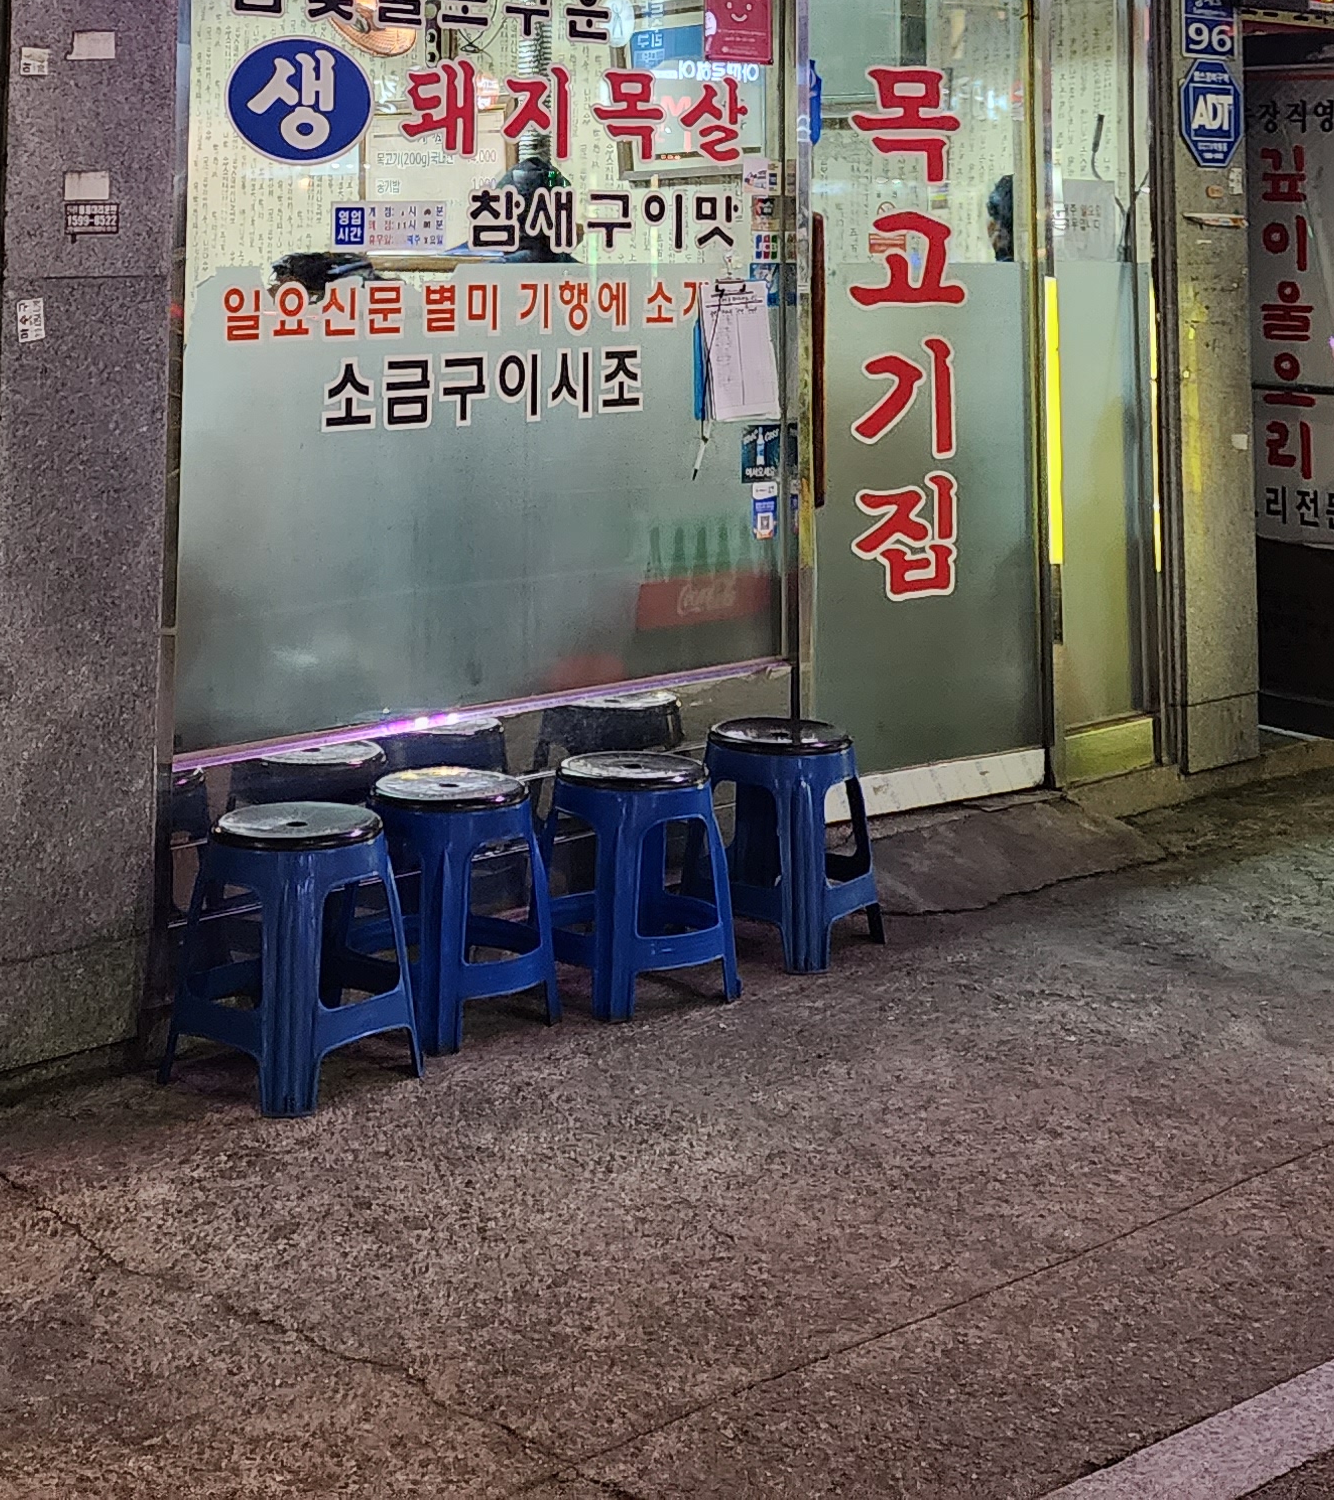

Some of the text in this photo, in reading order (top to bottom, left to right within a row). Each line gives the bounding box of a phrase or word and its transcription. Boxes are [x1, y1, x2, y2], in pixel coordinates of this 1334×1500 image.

[1187, 22, 1233, 53] 96
[246, 47, 338, 153] 생
[400, 59, 750, 162] 돼지목살
[1191, 93, 1234, 131] ADT
[337, 210, 363, 225] 영업
[337, 227, 363, 243] 시간
[468, 189, 742, 253] 참새구이맛
[223, 281, 405, 343] 일요신문
[423, 282, 501, 334] 별미
[519, 280, 630, 333] 기행에
[850, 66, 968, 604] 목고기집
[324, 346, 643, 429] 소금구이시조
